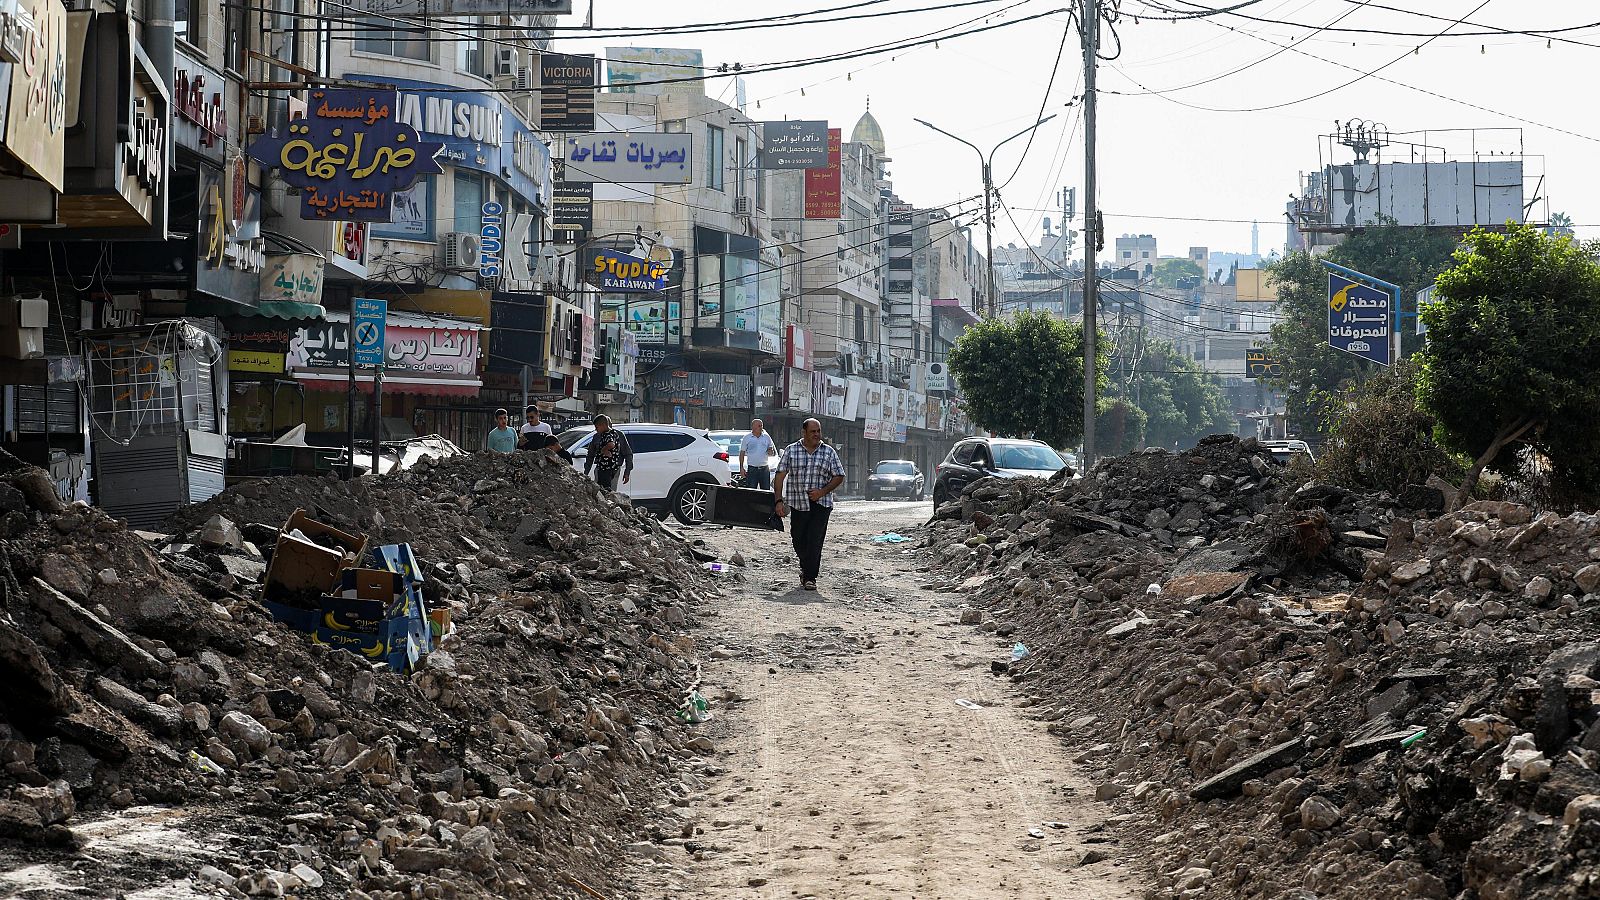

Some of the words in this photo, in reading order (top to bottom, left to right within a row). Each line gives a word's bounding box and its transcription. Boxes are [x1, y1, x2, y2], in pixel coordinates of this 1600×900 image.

[543, 67, 592, 78] VICTORIA
[313, 91, 389, 125] مؤسسة
[280, 124, 416, 179] ضراغمة
[569, 138, 617, 163] تفاحة
[626, 141, 686, 170] بصريات
[305, 186, 385, 217] التجارية
[480, 201, 503, 278] STUDIO
[604, 278, 656, 290] KARAWAN
[358, 301, 380, 311] مواقف
[1349, 296, 1387, 308] محطة
[1330, 325, 1387, 339] للمحروقات
[388, 330, 473, 362] الفارس
[412, 361, 426, 372] cd
[433, 362, 454, 373] هدايا
